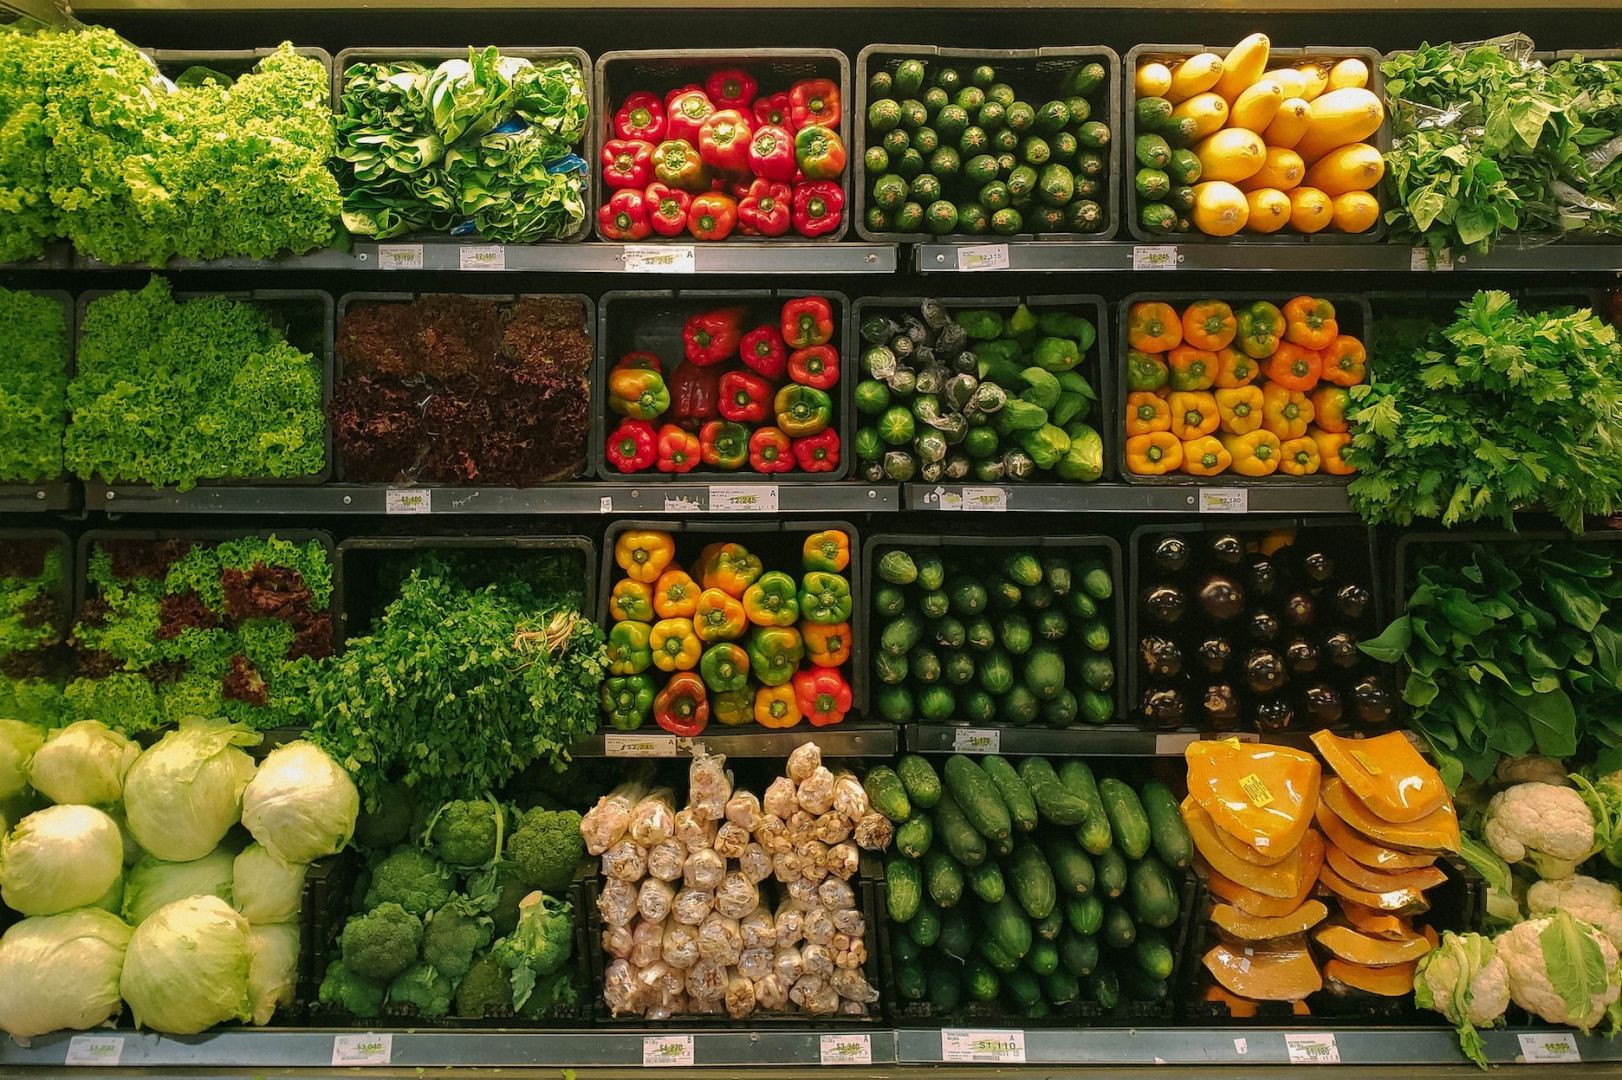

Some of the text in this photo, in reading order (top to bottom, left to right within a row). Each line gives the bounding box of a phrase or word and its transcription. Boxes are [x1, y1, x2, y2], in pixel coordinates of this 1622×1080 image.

[686, 250, 694, 258] A
[979, 253, 1002, 261] $2,115
[979, 1042, 1017, 1051] $1,110
